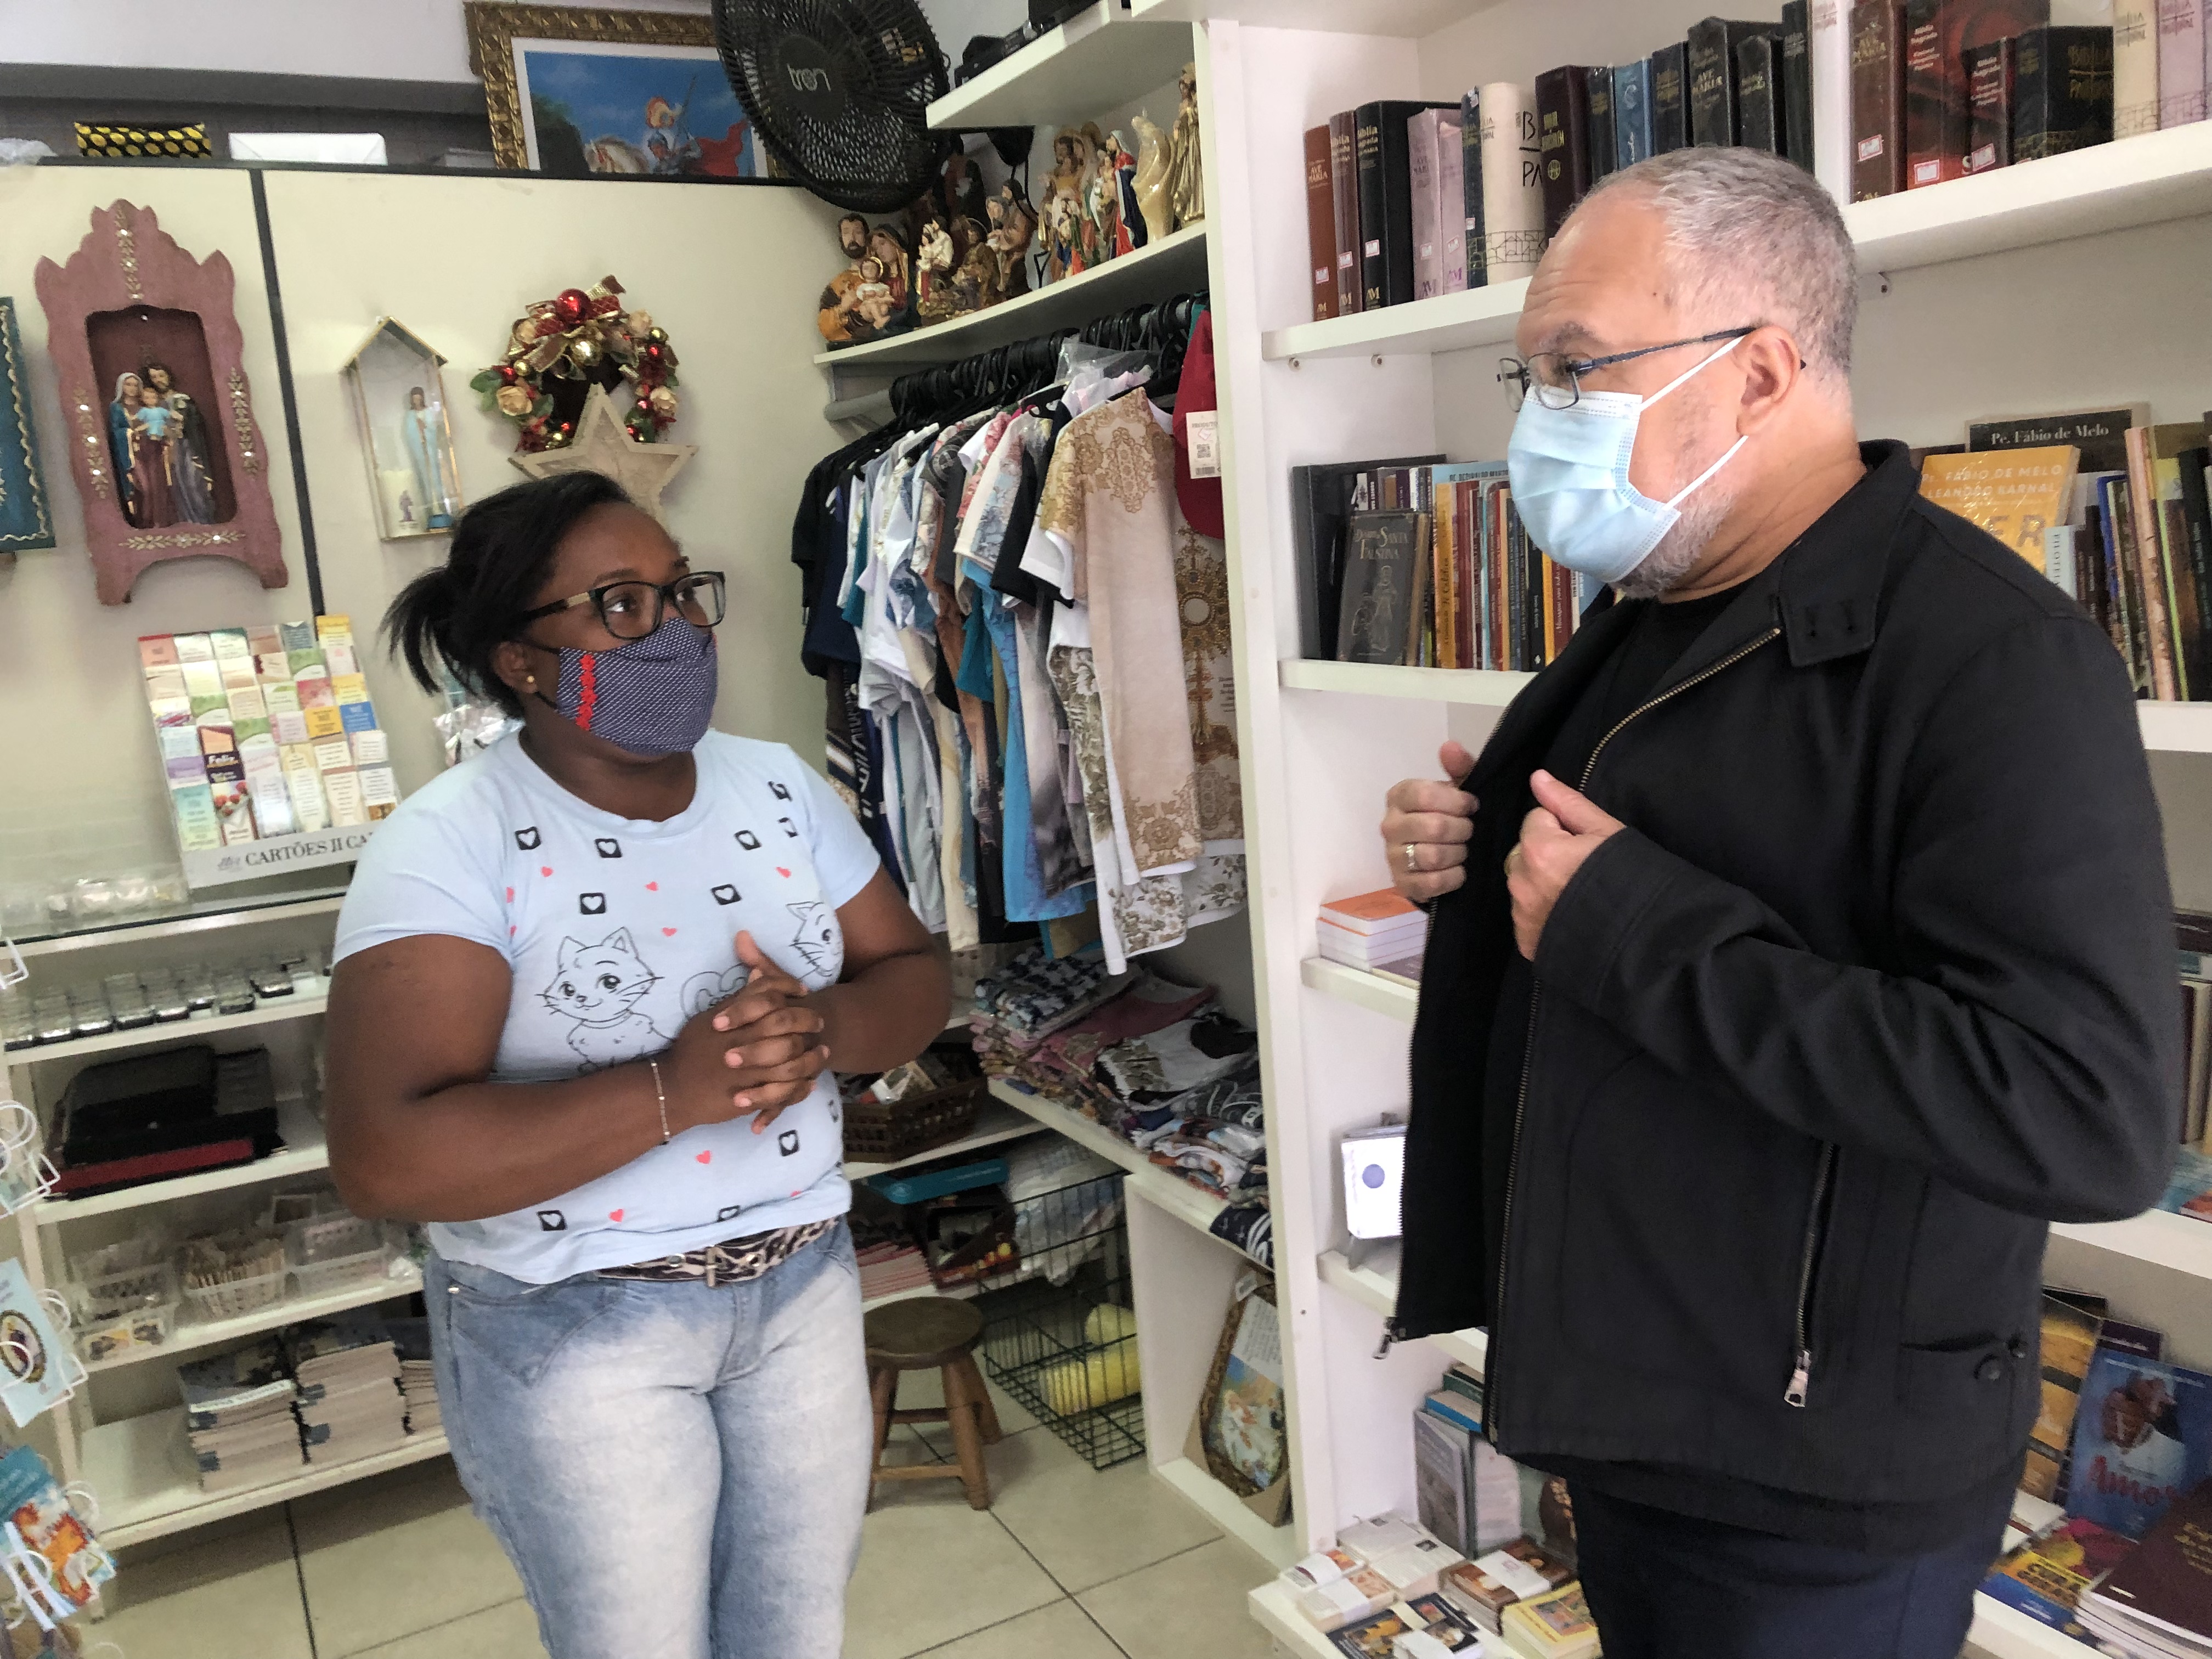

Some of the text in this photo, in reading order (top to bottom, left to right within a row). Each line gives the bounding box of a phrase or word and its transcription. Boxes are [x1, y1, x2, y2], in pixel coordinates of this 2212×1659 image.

[1991, 423, 2110, 445] Pe. Fábio de Melo
[2018, 465, 2063, 476] MELO
[245, 840, 328, 867] CARTÕES
